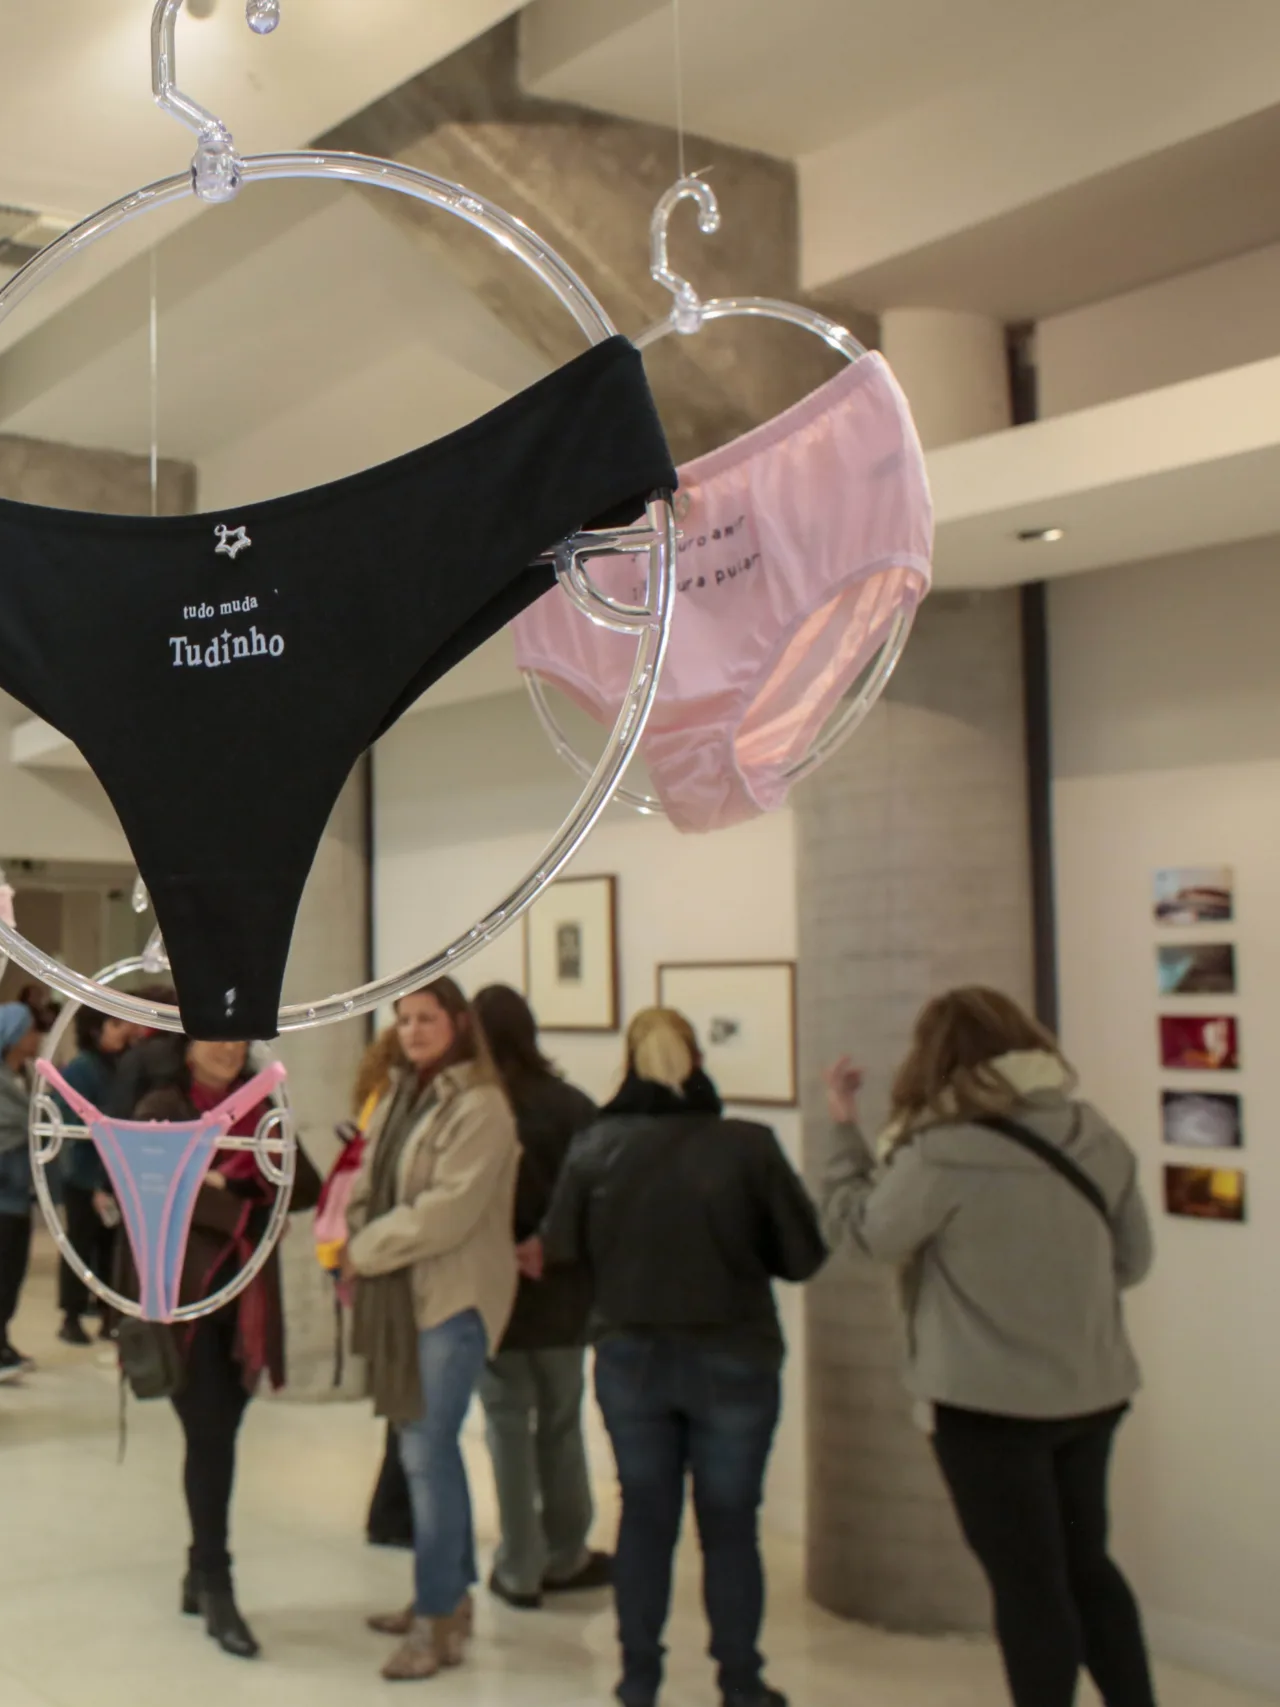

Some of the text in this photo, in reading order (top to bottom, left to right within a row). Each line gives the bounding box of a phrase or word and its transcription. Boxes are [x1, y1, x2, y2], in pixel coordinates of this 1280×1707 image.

[183, 596, 259, 620] tudo muda
[169, 625, 285, 668] Tudinho
